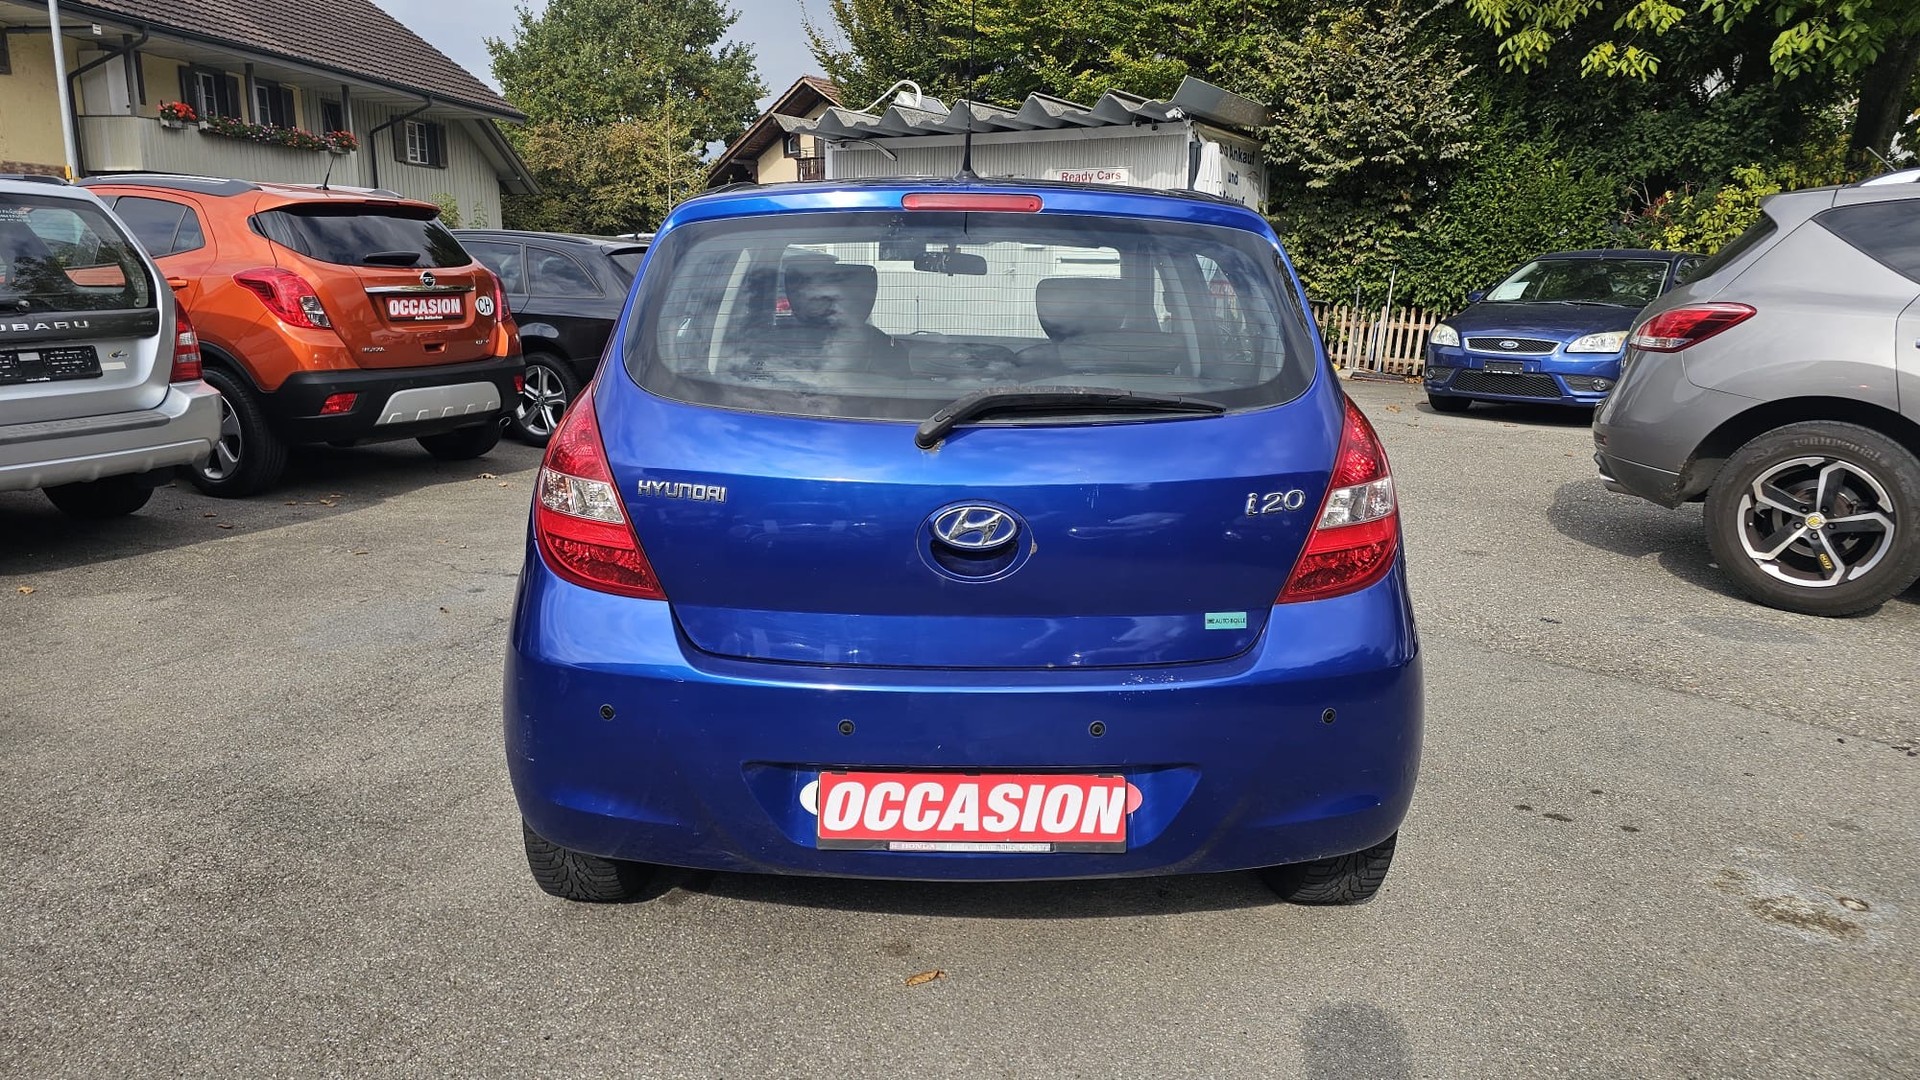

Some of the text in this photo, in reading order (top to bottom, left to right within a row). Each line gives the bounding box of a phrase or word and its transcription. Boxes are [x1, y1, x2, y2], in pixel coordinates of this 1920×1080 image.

[1061, 171, 1121, 184] Ready Cars
[389, 299, 461, 315] OCCASION
[478, 298, 494, 314] CH
[638, 480, 727, 503] HYUNDAI
[1245, 490, 1305, 515] i20
[823, 781, 1126, 835] OCCASION
